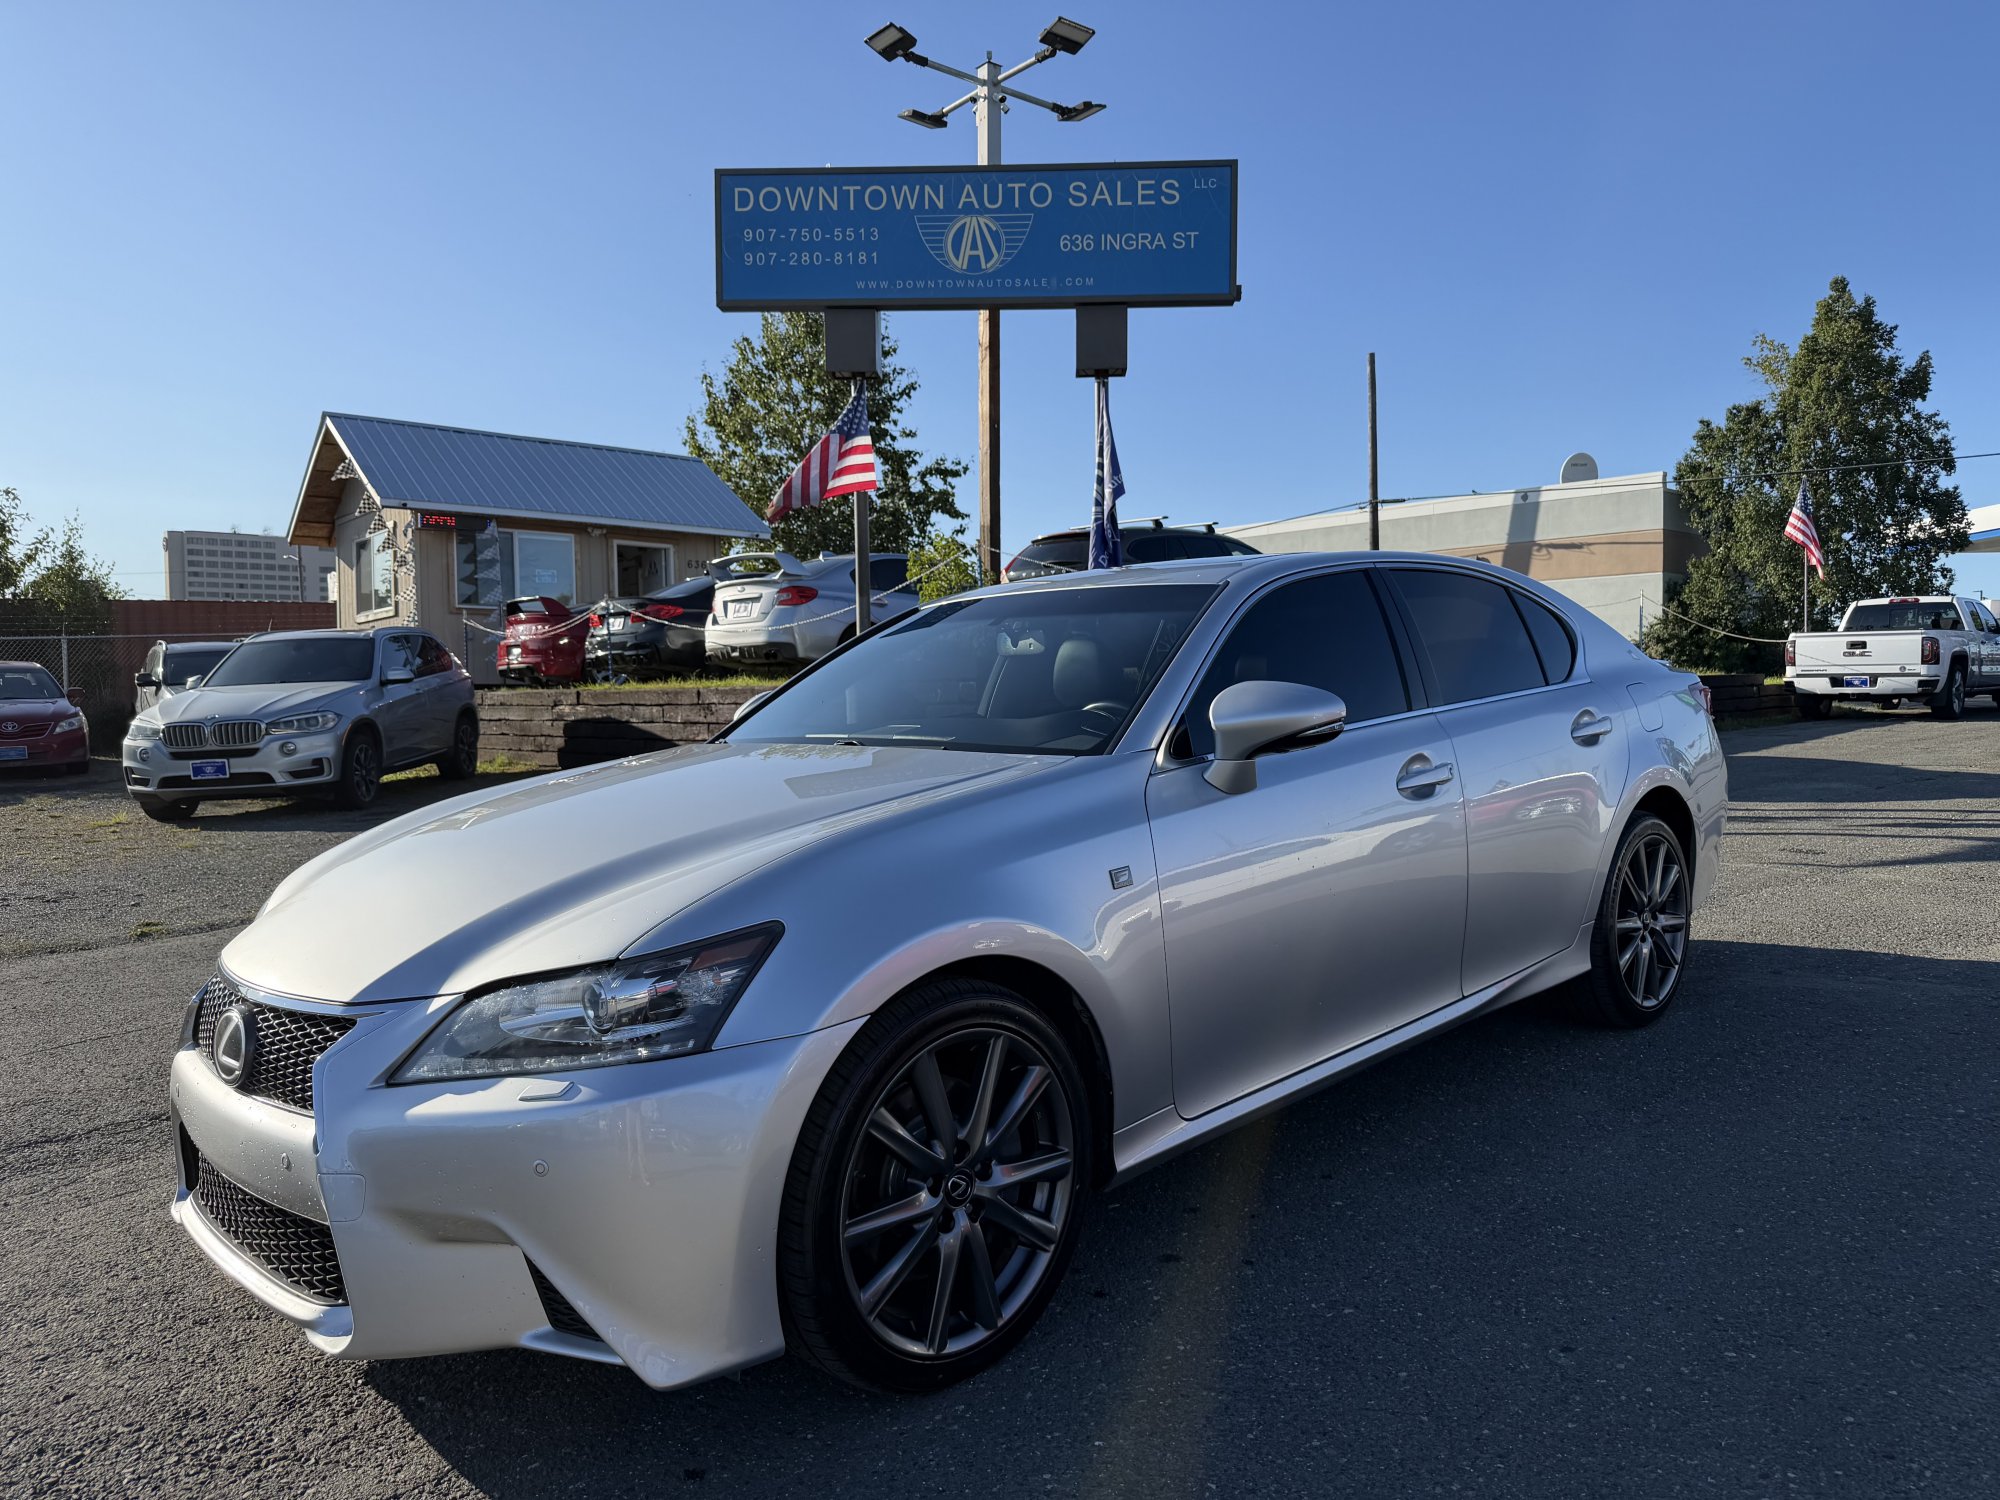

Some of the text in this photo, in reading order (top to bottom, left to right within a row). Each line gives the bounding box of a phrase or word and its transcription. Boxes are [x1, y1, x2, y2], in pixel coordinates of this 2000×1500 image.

[734, 178, 1218, 212] DOWNTOWN AUTO SALES LLC
[743, 227, 880, 242] 907-750-5513
[1059, 231, 1200, 252] 636 INGRA ST
[744, 251, 878, 266] 907-280-8181
[855, 278, 1095, 289] WWW.DOWNTOWNAUTOSALE.COM
[687, 560, 707, 569] 636
